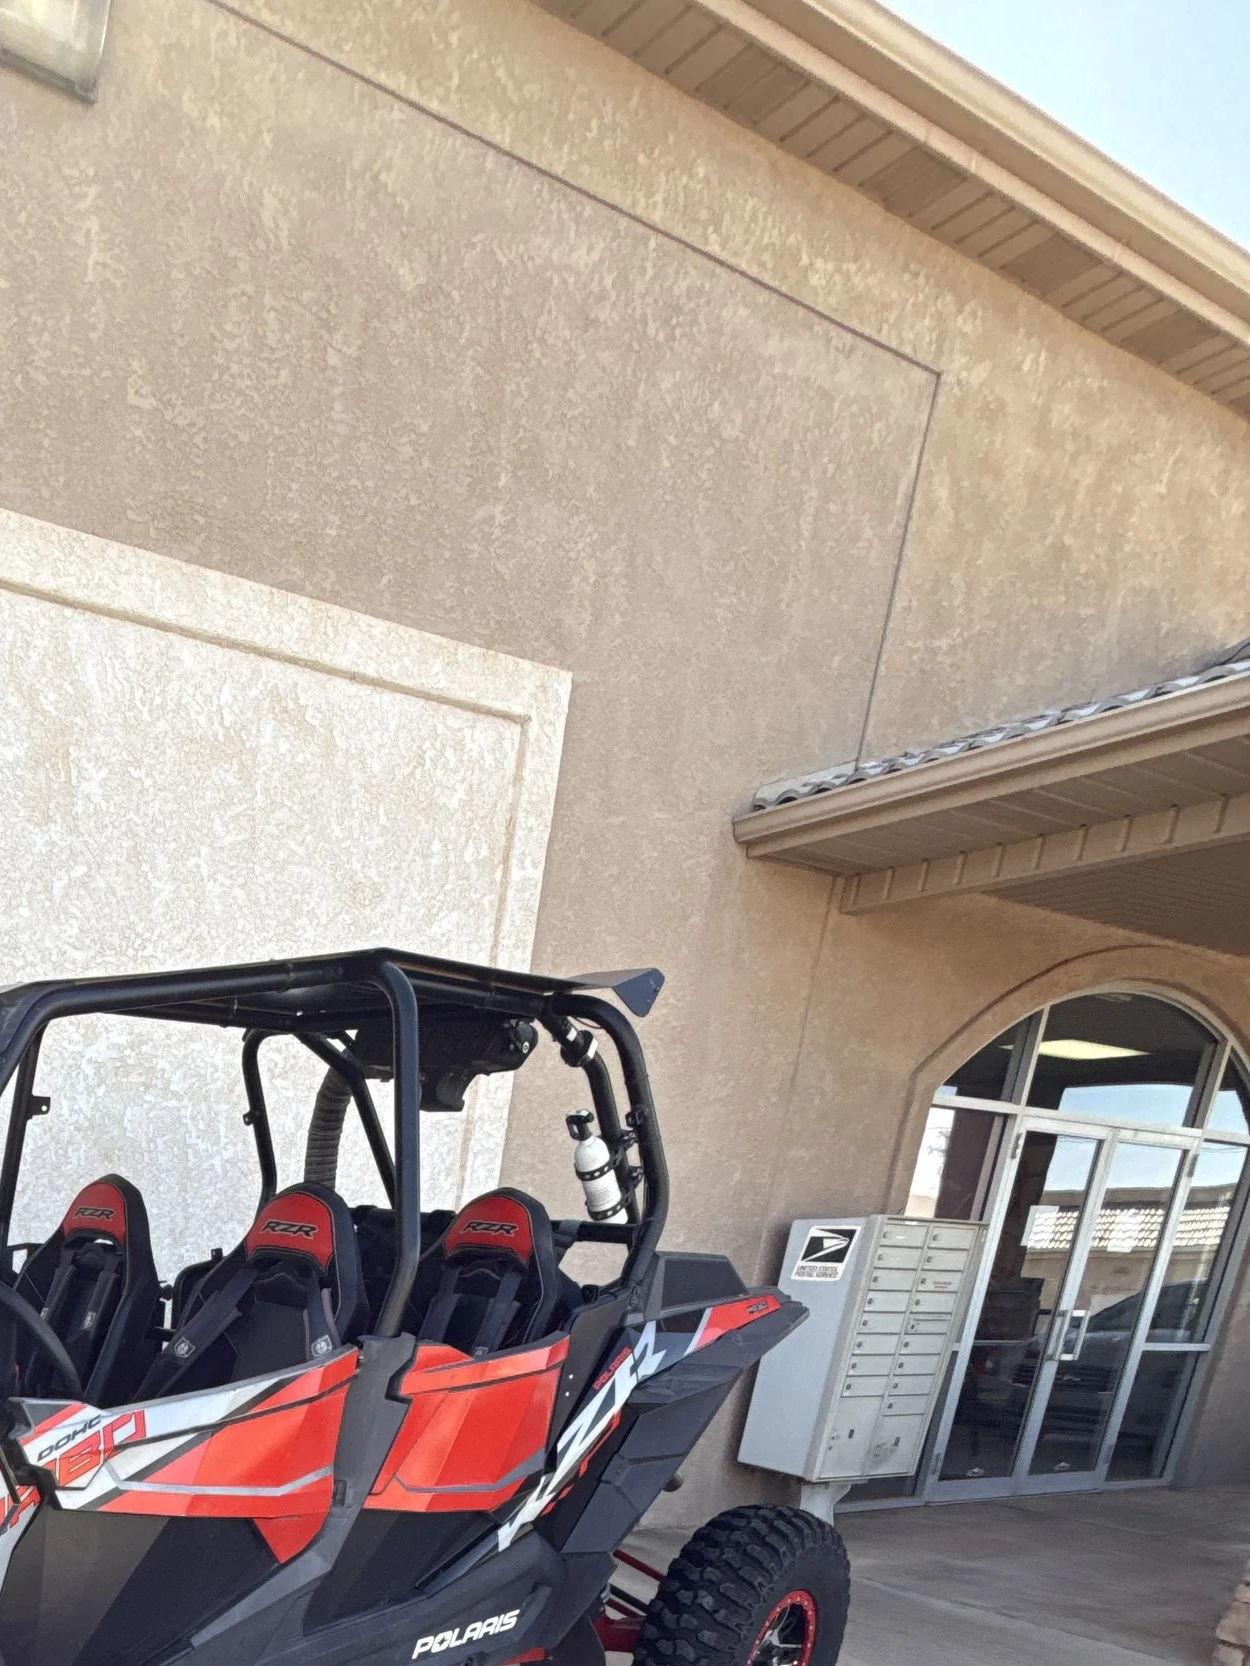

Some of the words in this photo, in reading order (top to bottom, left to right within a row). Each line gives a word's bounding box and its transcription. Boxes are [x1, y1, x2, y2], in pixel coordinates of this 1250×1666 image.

[72, 1207, 115, 1220] RZR
[460, 1220, 519, 1237] RZR
[259, 1220, 318, 1239] RZR
[593, 1346, 632, 1390] POLARIS
[37, 1414, 101, 1462] DOHC
[412, 1608, 520, 1660] POLARIS
